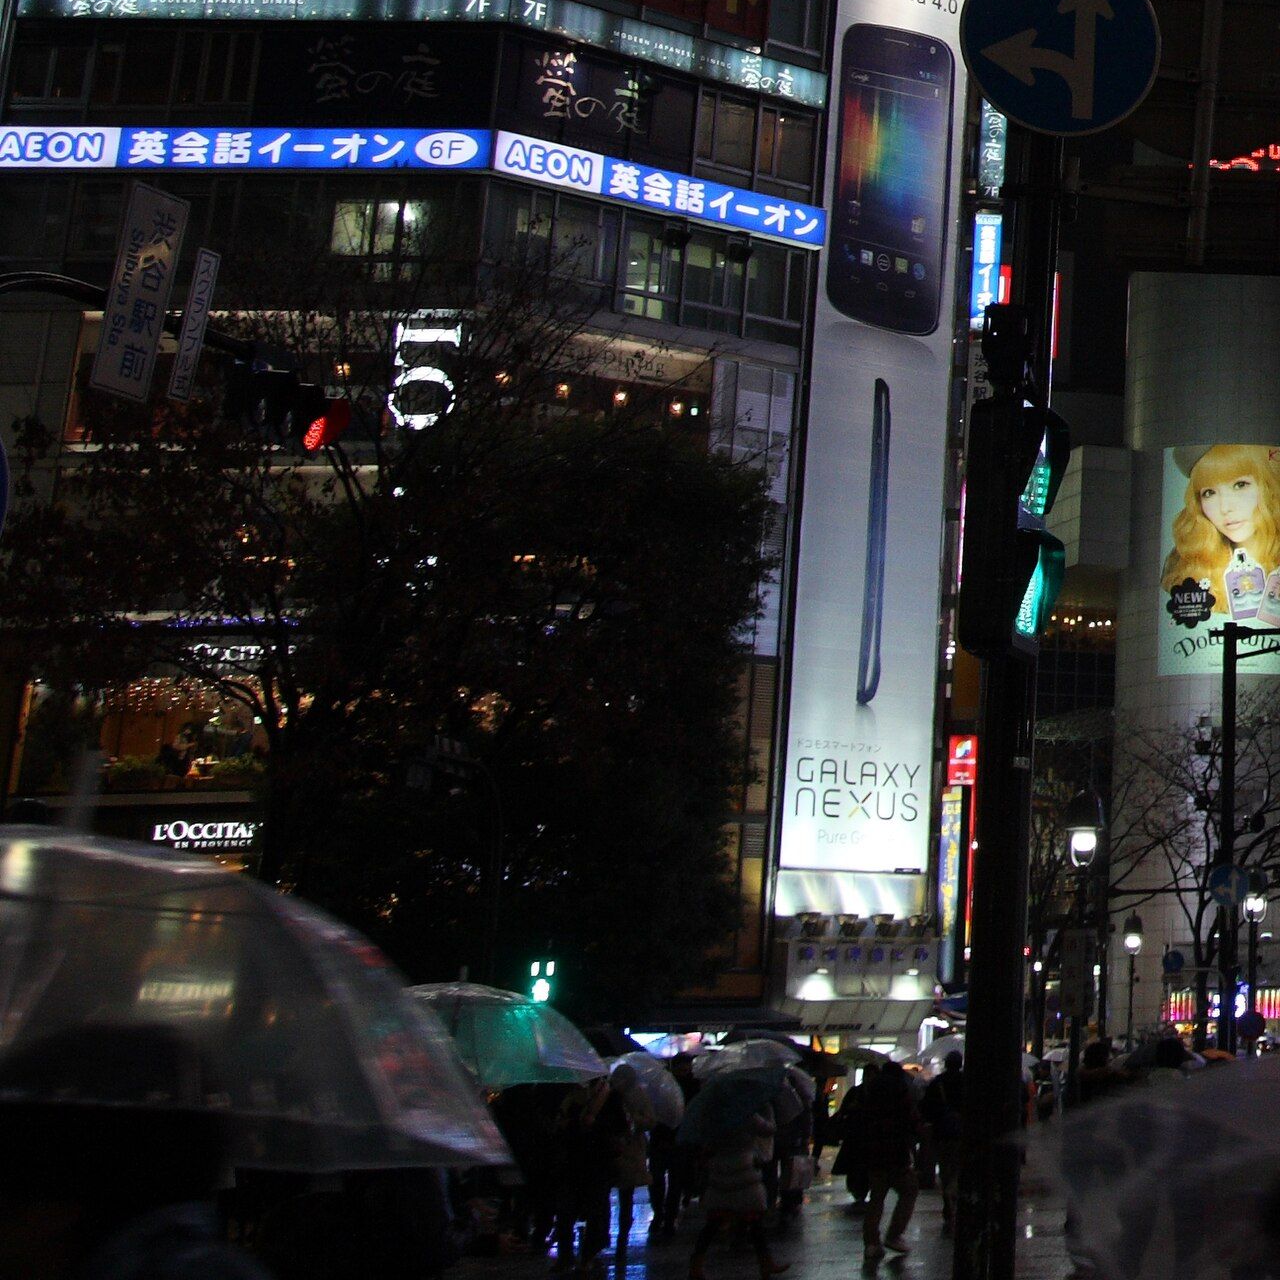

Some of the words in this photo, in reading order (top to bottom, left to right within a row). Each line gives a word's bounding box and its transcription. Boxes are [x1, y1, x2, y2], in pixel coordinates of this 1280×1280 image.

[523, 0, 547, 21] 7F
[613, 30, 650, 46] MODERN
[700, 54, 732, 70] DINING
[0, 131, 104, 162] AEON
[128, 130, 405, 166] 英会話イーオン
[429, 139, 464, 160] 6F
[504, 139, 593, 186] AEON
[610, 163, 818, 236] 英会話イーオン
[1174, 591, 1207, 604] NEW!
[796, 756, 921, 789] GALAXY
[794, 786, 920, 822] NEXUS
[816, 828, 848, 846] Pure
